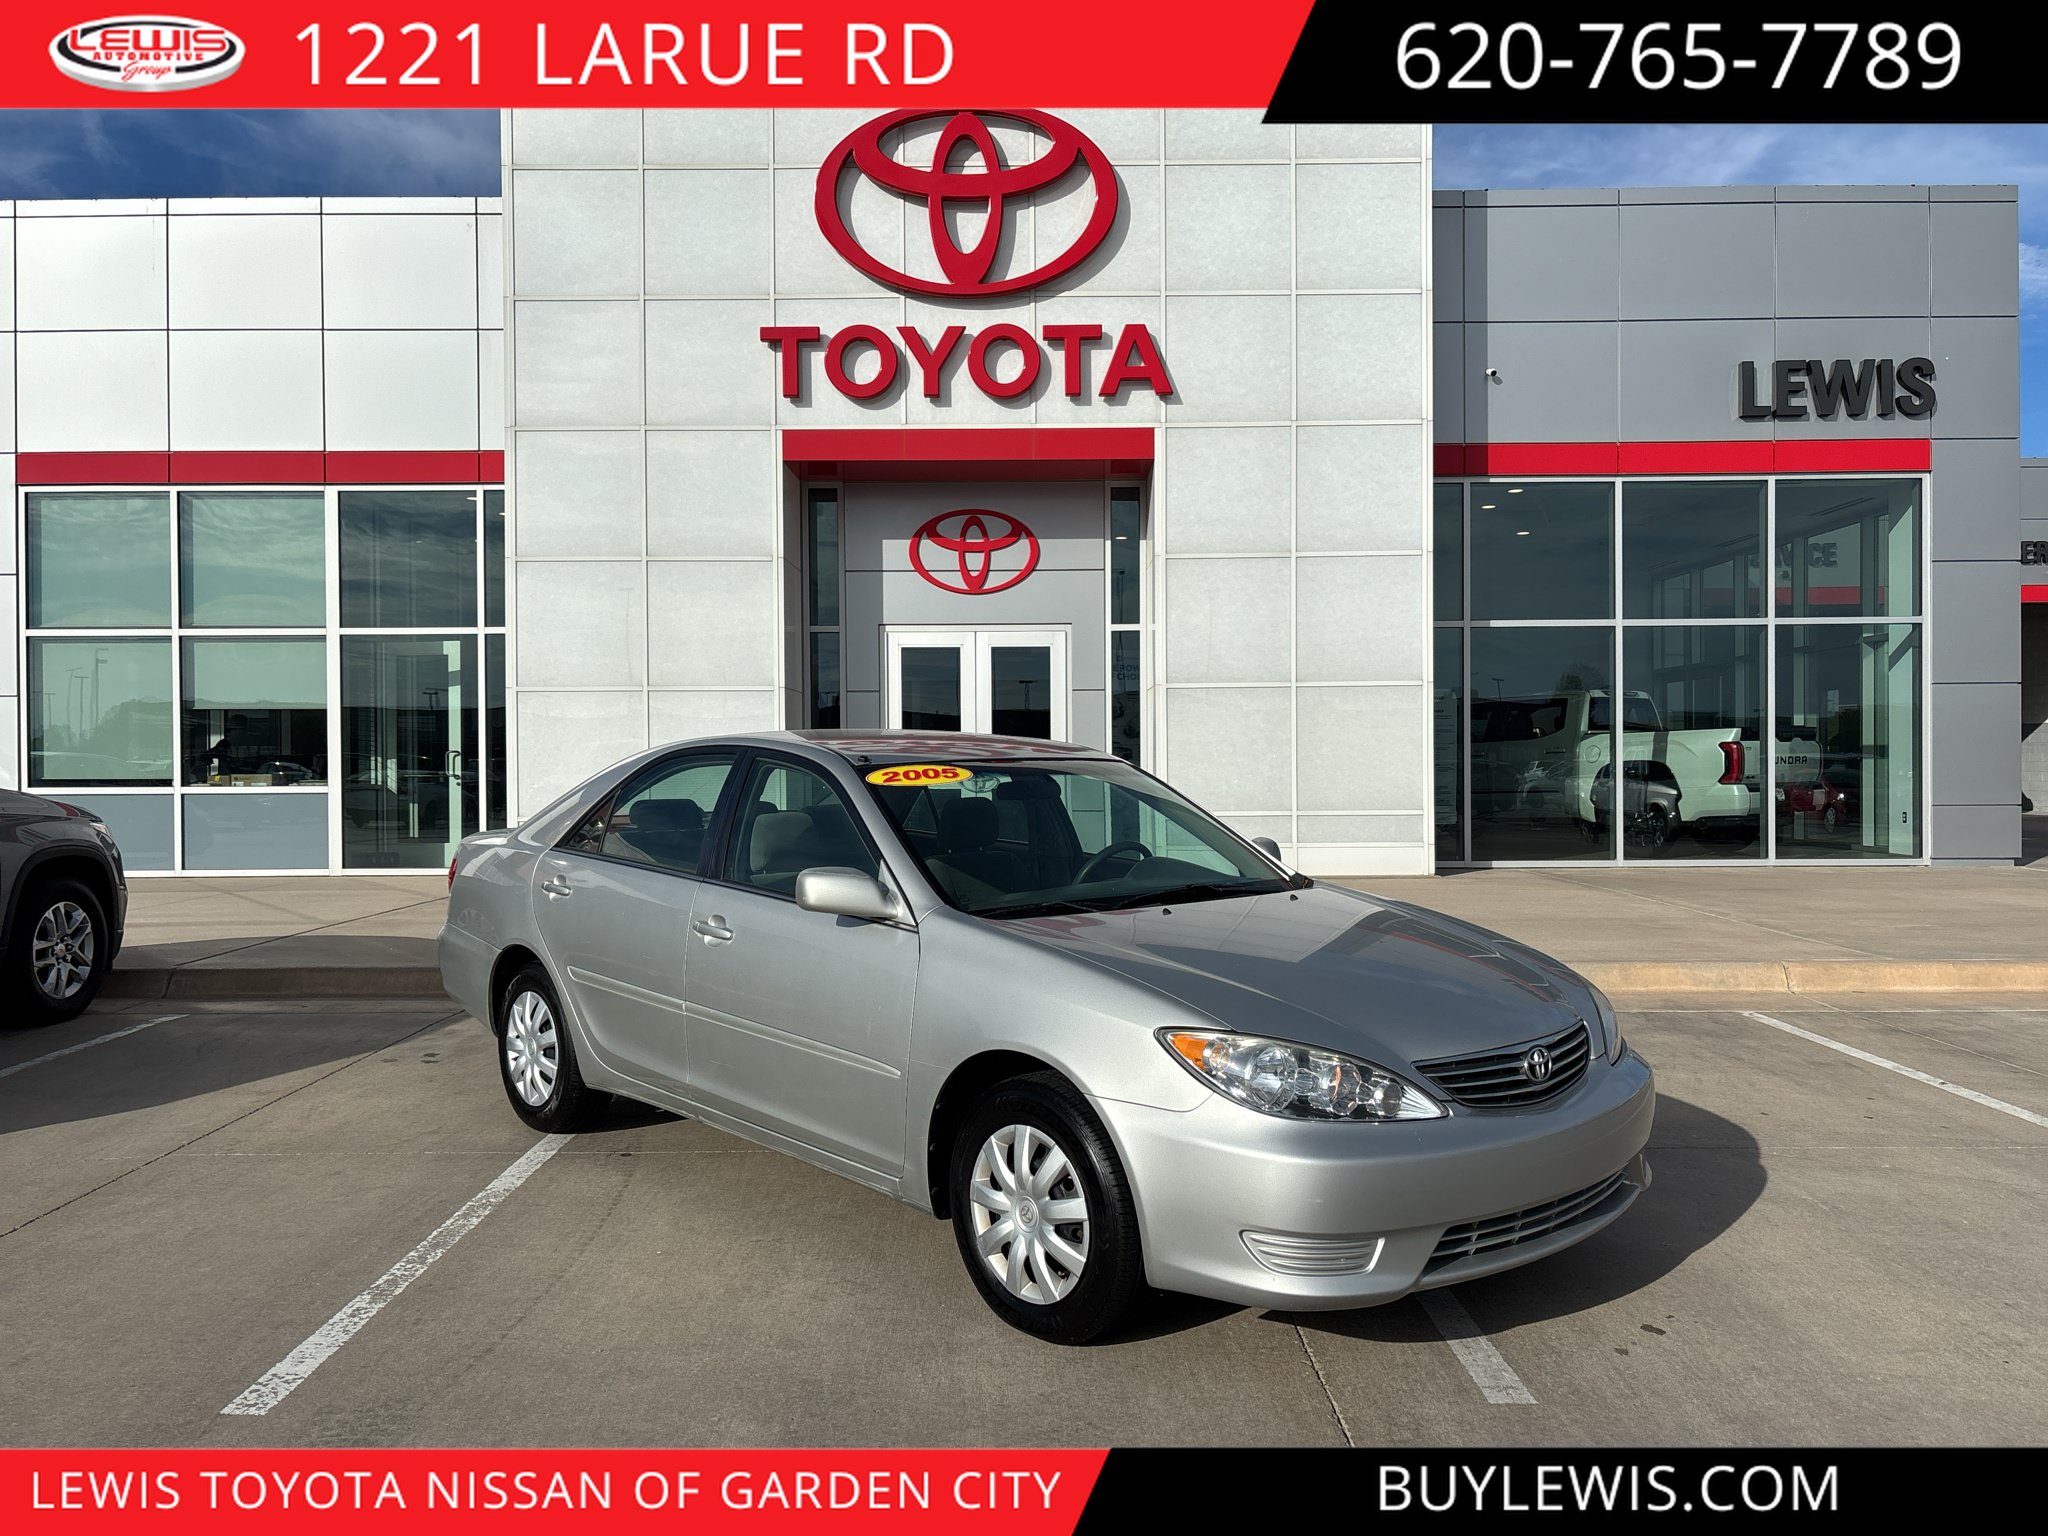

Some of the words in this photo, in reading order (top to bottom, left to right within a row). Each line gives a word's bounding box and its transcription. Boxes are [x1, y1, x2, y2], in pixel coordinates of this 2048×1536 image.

[760, 323, 1174, 400] TOYOTA
[1738, 357, 1937, 419] LEWIS
[881, 767, 961, 783] 2005
[1775, 755, 1808, 765] UNDRA
